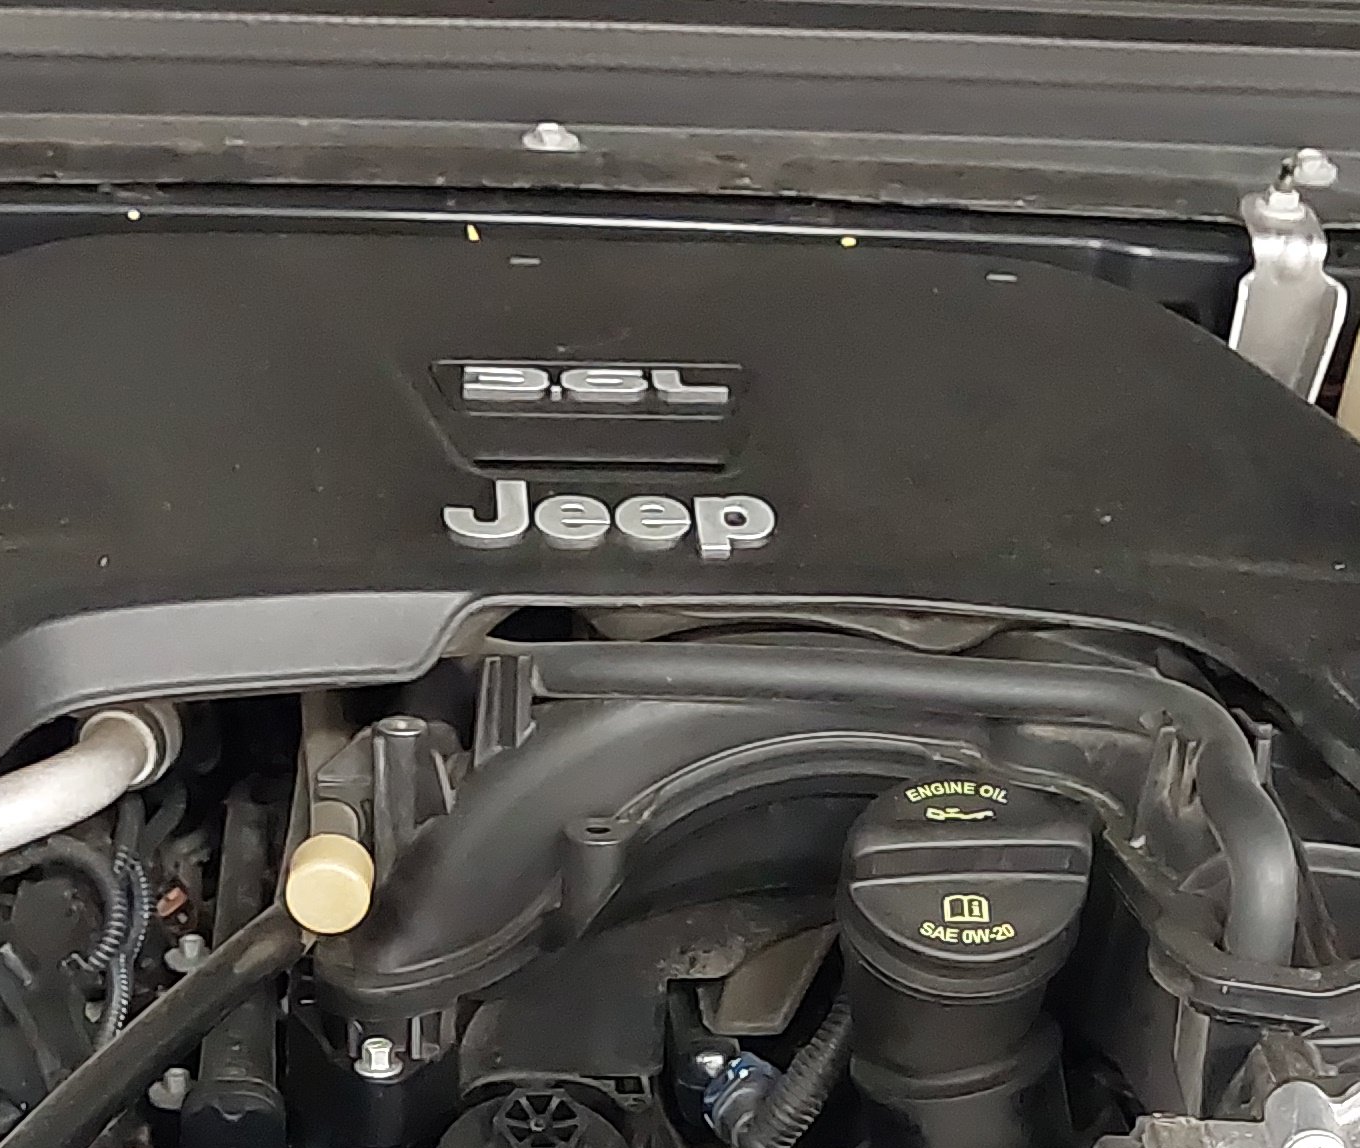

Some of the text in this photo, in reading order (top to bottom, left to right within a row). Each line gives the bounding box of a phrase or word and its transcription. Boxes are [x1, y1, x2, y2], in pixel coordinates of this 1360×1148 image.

[462, 364, 730, 403] 3.6L
[441, 479, 778, 560] Jeep
[905, 780, 1009, 805] ENGINE OIL
[919, 921, 1016, 945] SAE 0W-20
